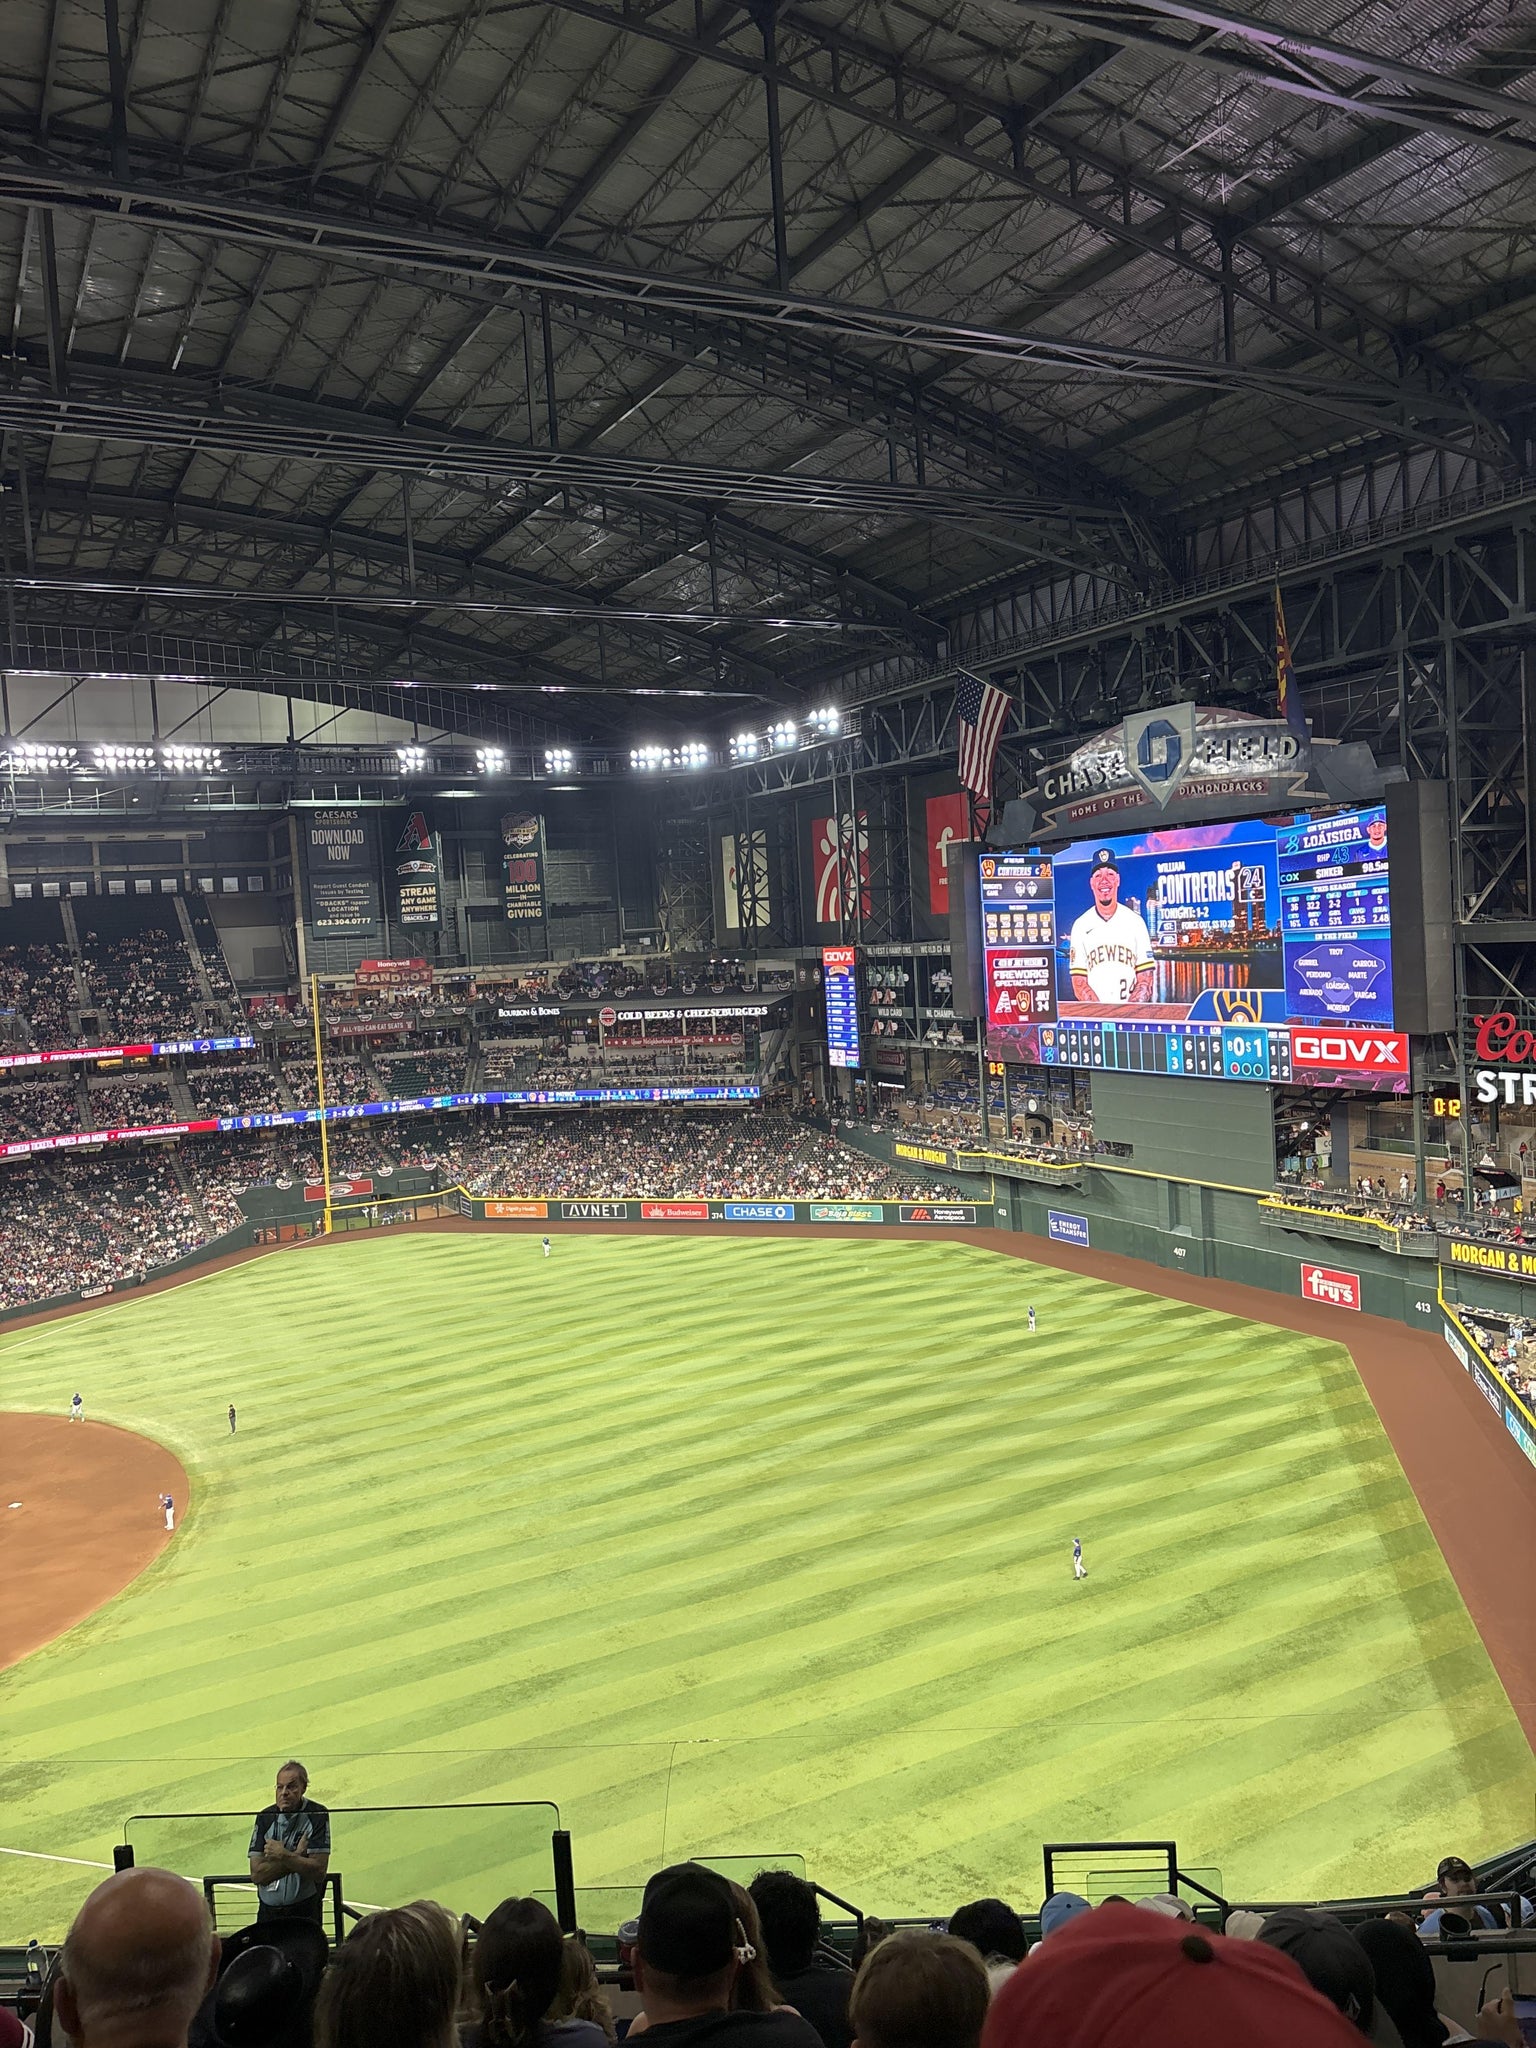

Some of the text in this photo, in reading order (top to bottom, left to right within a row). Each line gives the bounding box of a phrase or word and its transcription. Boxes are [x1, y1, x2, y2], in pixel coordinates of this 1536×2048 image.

[1043, 735, 1301, 800] CHASE FIELD
[1178, 781, 1264, 796] DIAMONDBACKS
[1071, 793, 1143, 818] HOME OF THE
[314, 810, 359, 820] CAESARS
[1318, 816, 1359, 830] THE MOUND
[311, 829, 364, 845] DOWNLOAD
[1303, 827, 1363, 849] LOÁISIGA
[327, 845, 351, 861] NOW
[503, 852, 538, 860] CELEBRATING
[1316, 846, 1350, 864] RHP 43
[997, 863, 1052, 877] CONTRERAS 24
[1157, 861, 1186, 873] WILLIAM
[1243, 868, 1262, 888] 24
[1280, 866, 1344, 883] COX SINKER
[400, 887, 436, 897] STREAM
[506, 884, 541, 894] MILLION
[1158, 869, 1235, 905] CONTRERAS
[1312, 882, 1357, 893] THIS SEASON
[401, 896, 436, 905] ANY GAME
[1249, 891, 1256, 899] C
[401, 905, 437, 913] ANYWHERE
[507, 900, 542, 908] CHARITABLE
[1290, 895, 1383, 912] 36 32.2 2-2 5
[507, 908, 542, 919] GIVING
[1159, 906, 1210, 920] TONIGHT: 1-2
[317, 917, 371, 926] 623.304.0777
[1181, 920, 1212, 931] FORCE OUT,
[1289, 914, 1390, 927] 16% 6% 53% .235 2.48
[1338, 932, 1358, 940] FIELD
[825, 951, 853, 962] GOVX
[1329, 948, 1344, 956] TROY
[376, 960, 411, 969] Honeywell
[1352, 960, 1378, 968] CARROLL
[358, 970, 431, 985] SANDLOT
[993, 968, 1049, 980] FIREWORKS
[1306, 971, 1332, 979] PERDOMO
[1348, 971, 1368, 979] MARTE
[994, 978, 1049, 987] SPECTACULARS
[1354, 991, 1377, 999] VARGAS
[531, 1007, 538, 1016] &
[617, 1006, 768, 1020] COLD BEERS & CHEESEBURGERS
[877, 1008, 903, 1017] WILD CARD
[926, 1009, 932, 1018] NL
[342, 1021, 404, 1033] ALL-YOU-CAN-EAT SEATS
[1209, 1026, 1222, 1035] LOB
[642, 1036, 704, 1045] Neighborhood Burger Joint
[1059, 1034, 1220, 1053] 0 2 1 0 3 6 1 5
[159, 1042, 194, 1054] 8:16 PM
[1227, 1036, 1262, 1058] B 0 S 1
[1270, 1045, 1288, 1057] 1 3
[1294, 1036, 1400, 1064] GOVX
[14, 1049, 124, 1066] AND MORE FRYSFOOD.COM/DBACKS
[1059, 1051, 1222, 1072] 0 0 3 0 3 5 1 4
[1270, 1064, 1290, 1077] 2 2
[220, 1118, 233, 1126] DUE
[55, 1136, 77, 1147] PRIZES
[77, 1134, 91, 1144] AND
[91, 1132, 109, 1143] MORE
[117, 1125, 189, 1140] FRYSFOOD.COM/DBACKS
[895, 1143, 947, 1165] MORGAN & MORGAN
[569, 1204, 619, 1217] AVNET
[666, 1208, 702, 1217] Budweiser
[711, 1211, 724, 1220] 374
[732, 1206, 773, 1218] CHASE
[933, 1208, 964, 1216] Honeywell
[997, 1208, 1008, 1217] 413
[933, 1214, 966, 1222] Aerospace
[1058, 1219, 1081, 1231] ENERGY
[1058, 1225, 1088, 1239] TRANSFER
[1173, 1247, 1187, 1258] 407
[1450, 1242, 1519, 1272] MORGAN &
[1307, 1269, 1354, 1303] fry's
[1415, 1301, 1431, 1314] 413
